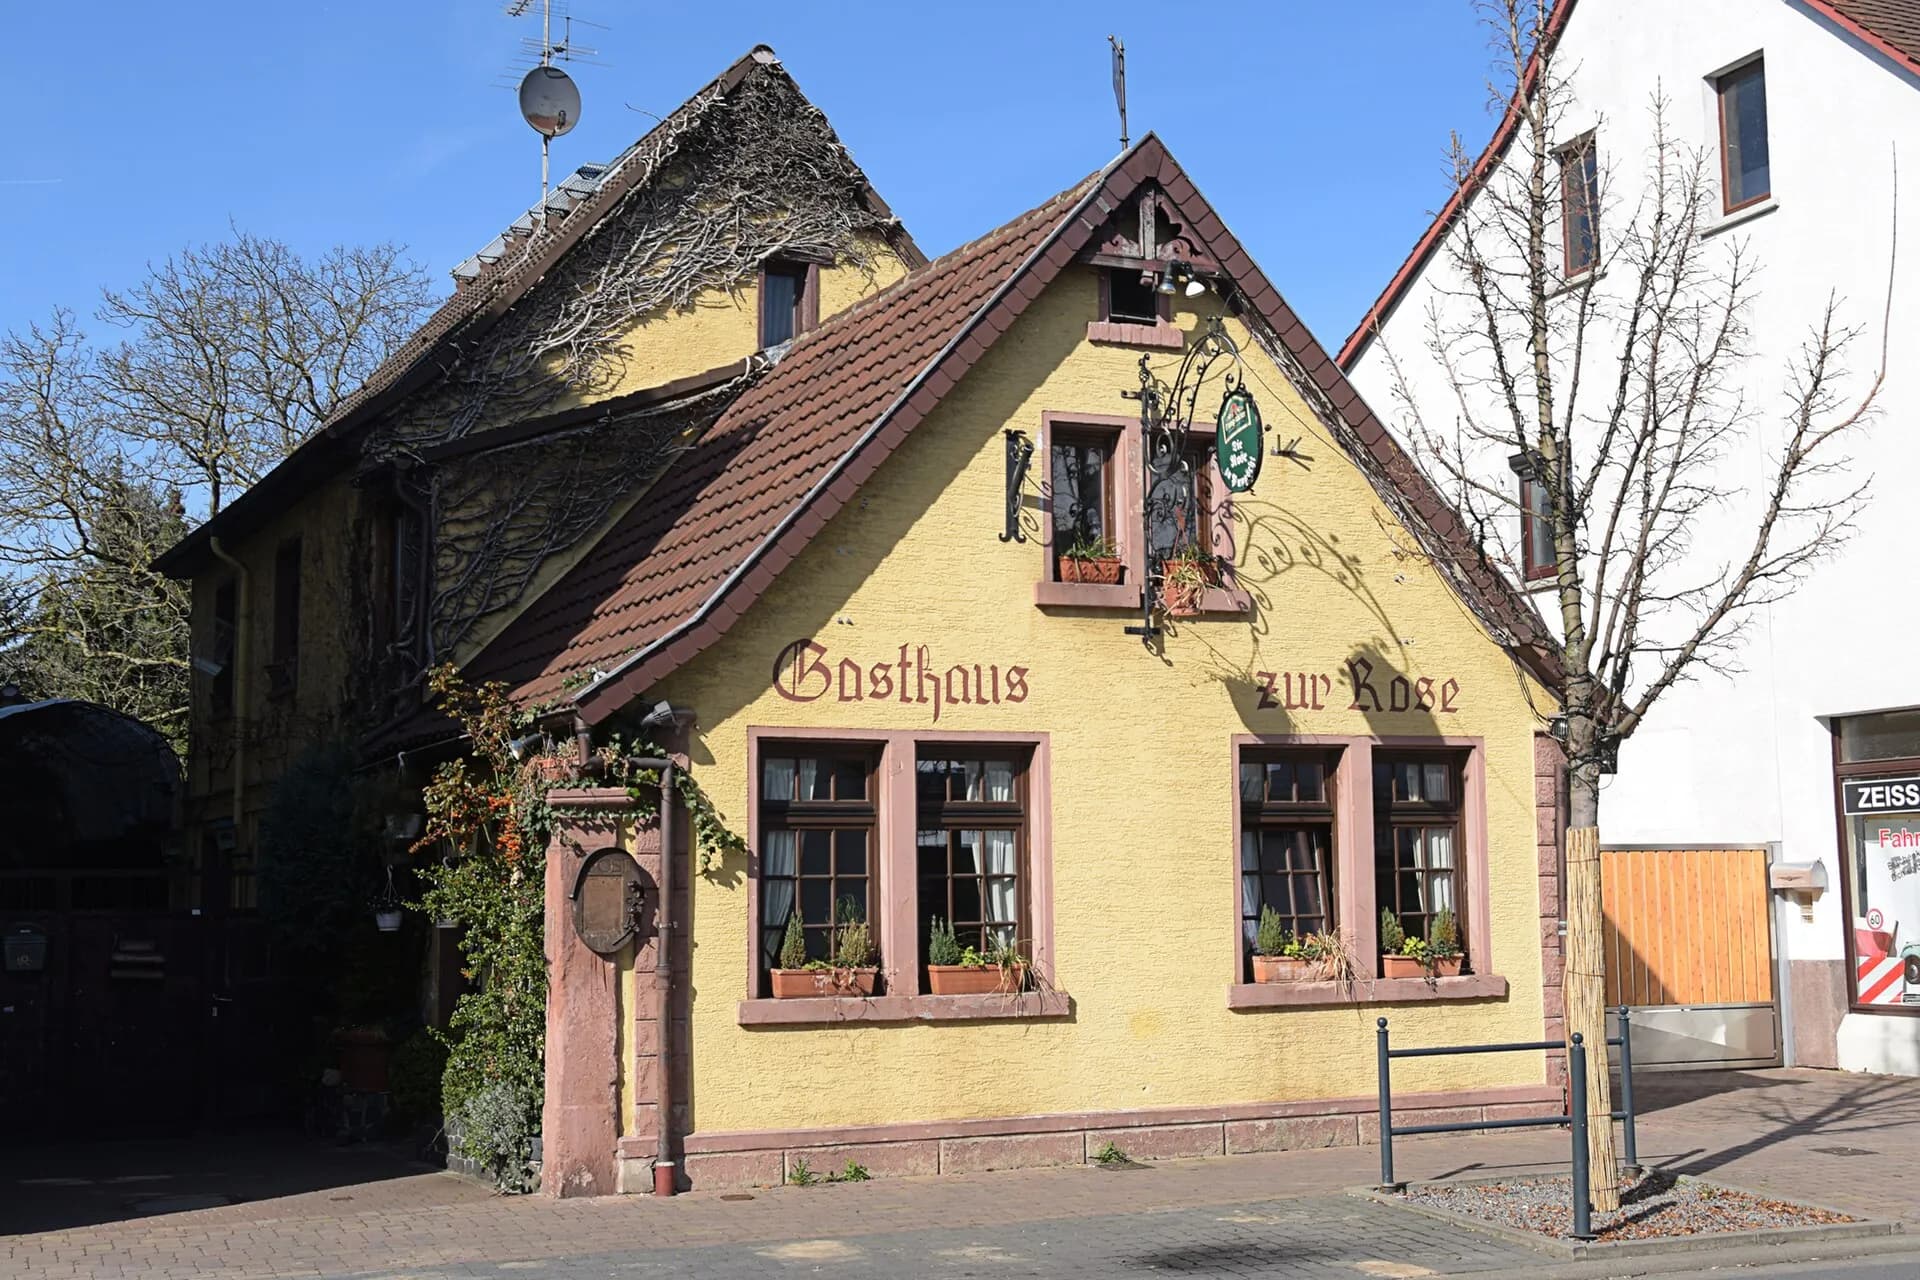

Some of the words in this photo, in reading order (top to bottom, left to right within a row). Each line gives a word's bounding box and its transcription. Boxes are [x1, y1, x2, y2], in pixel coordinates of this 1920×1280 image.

[772, 638, 1029, 724] Gasthaus
[1255, 670, 1331, 710] zur
[1344, 656, 1460, 712] Rose
[1857, 784, 1920, 809] ZEISS
[1870, 914, 1881, 925] 60
